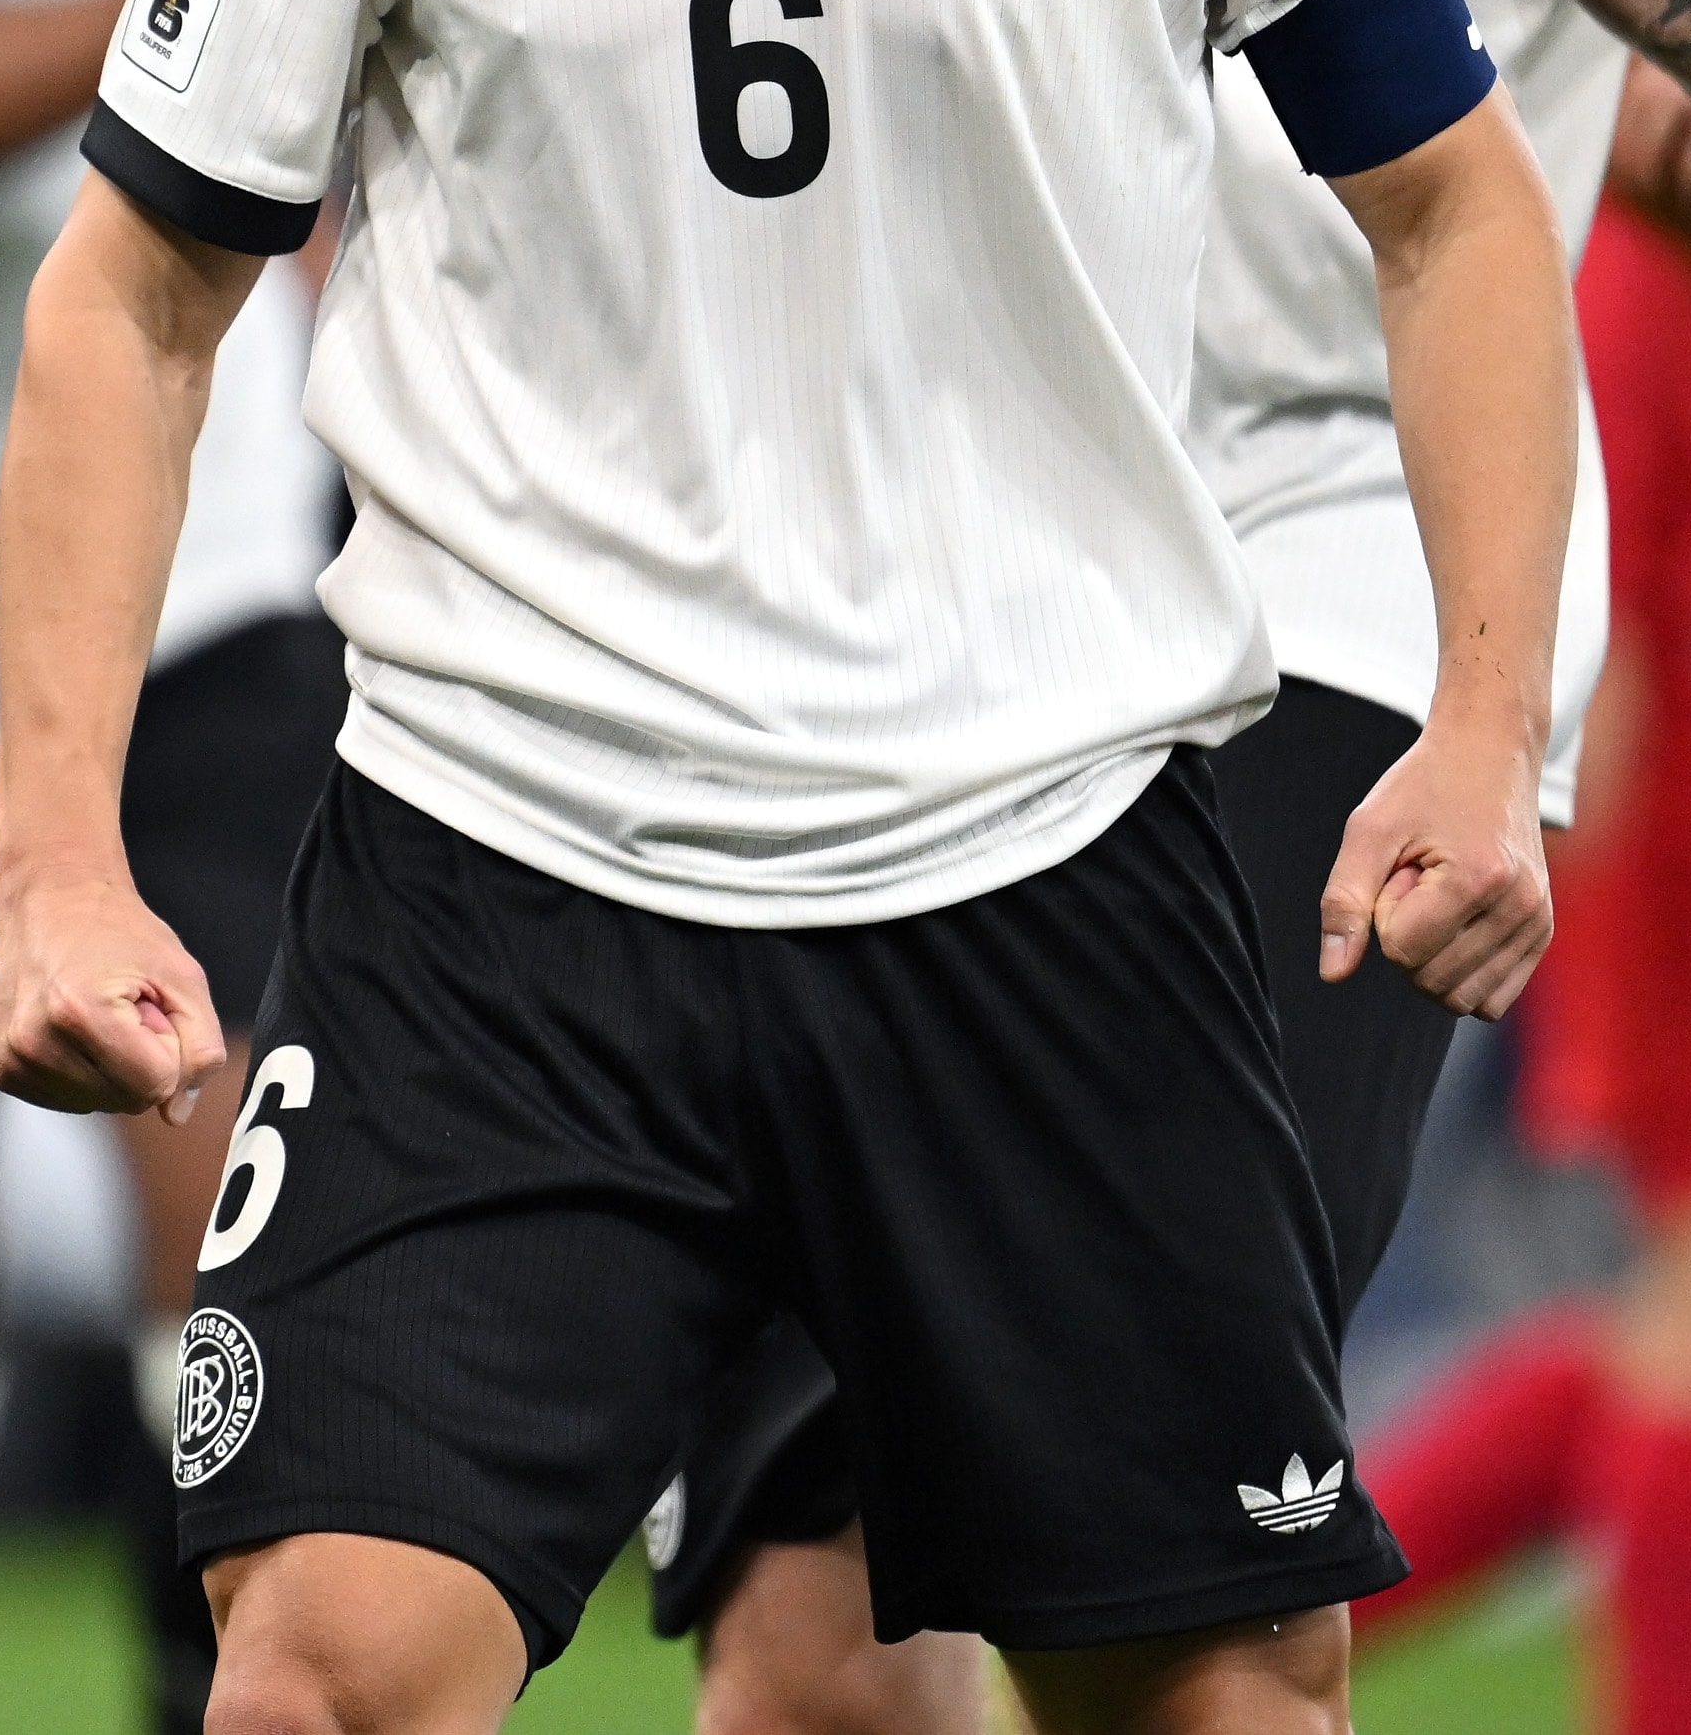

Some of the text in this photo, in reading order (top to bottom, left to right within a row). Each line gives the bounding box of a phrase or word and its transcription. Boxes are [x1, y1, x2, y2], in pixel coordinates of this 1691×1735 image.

[139, 31, 172, 60] QUALIFIERS
[154, 12, 172, 33] FIFA
[196, 1045, 315, 1272] 6
[190, 1317, 254, 1459] FUSSBALL-BUND
